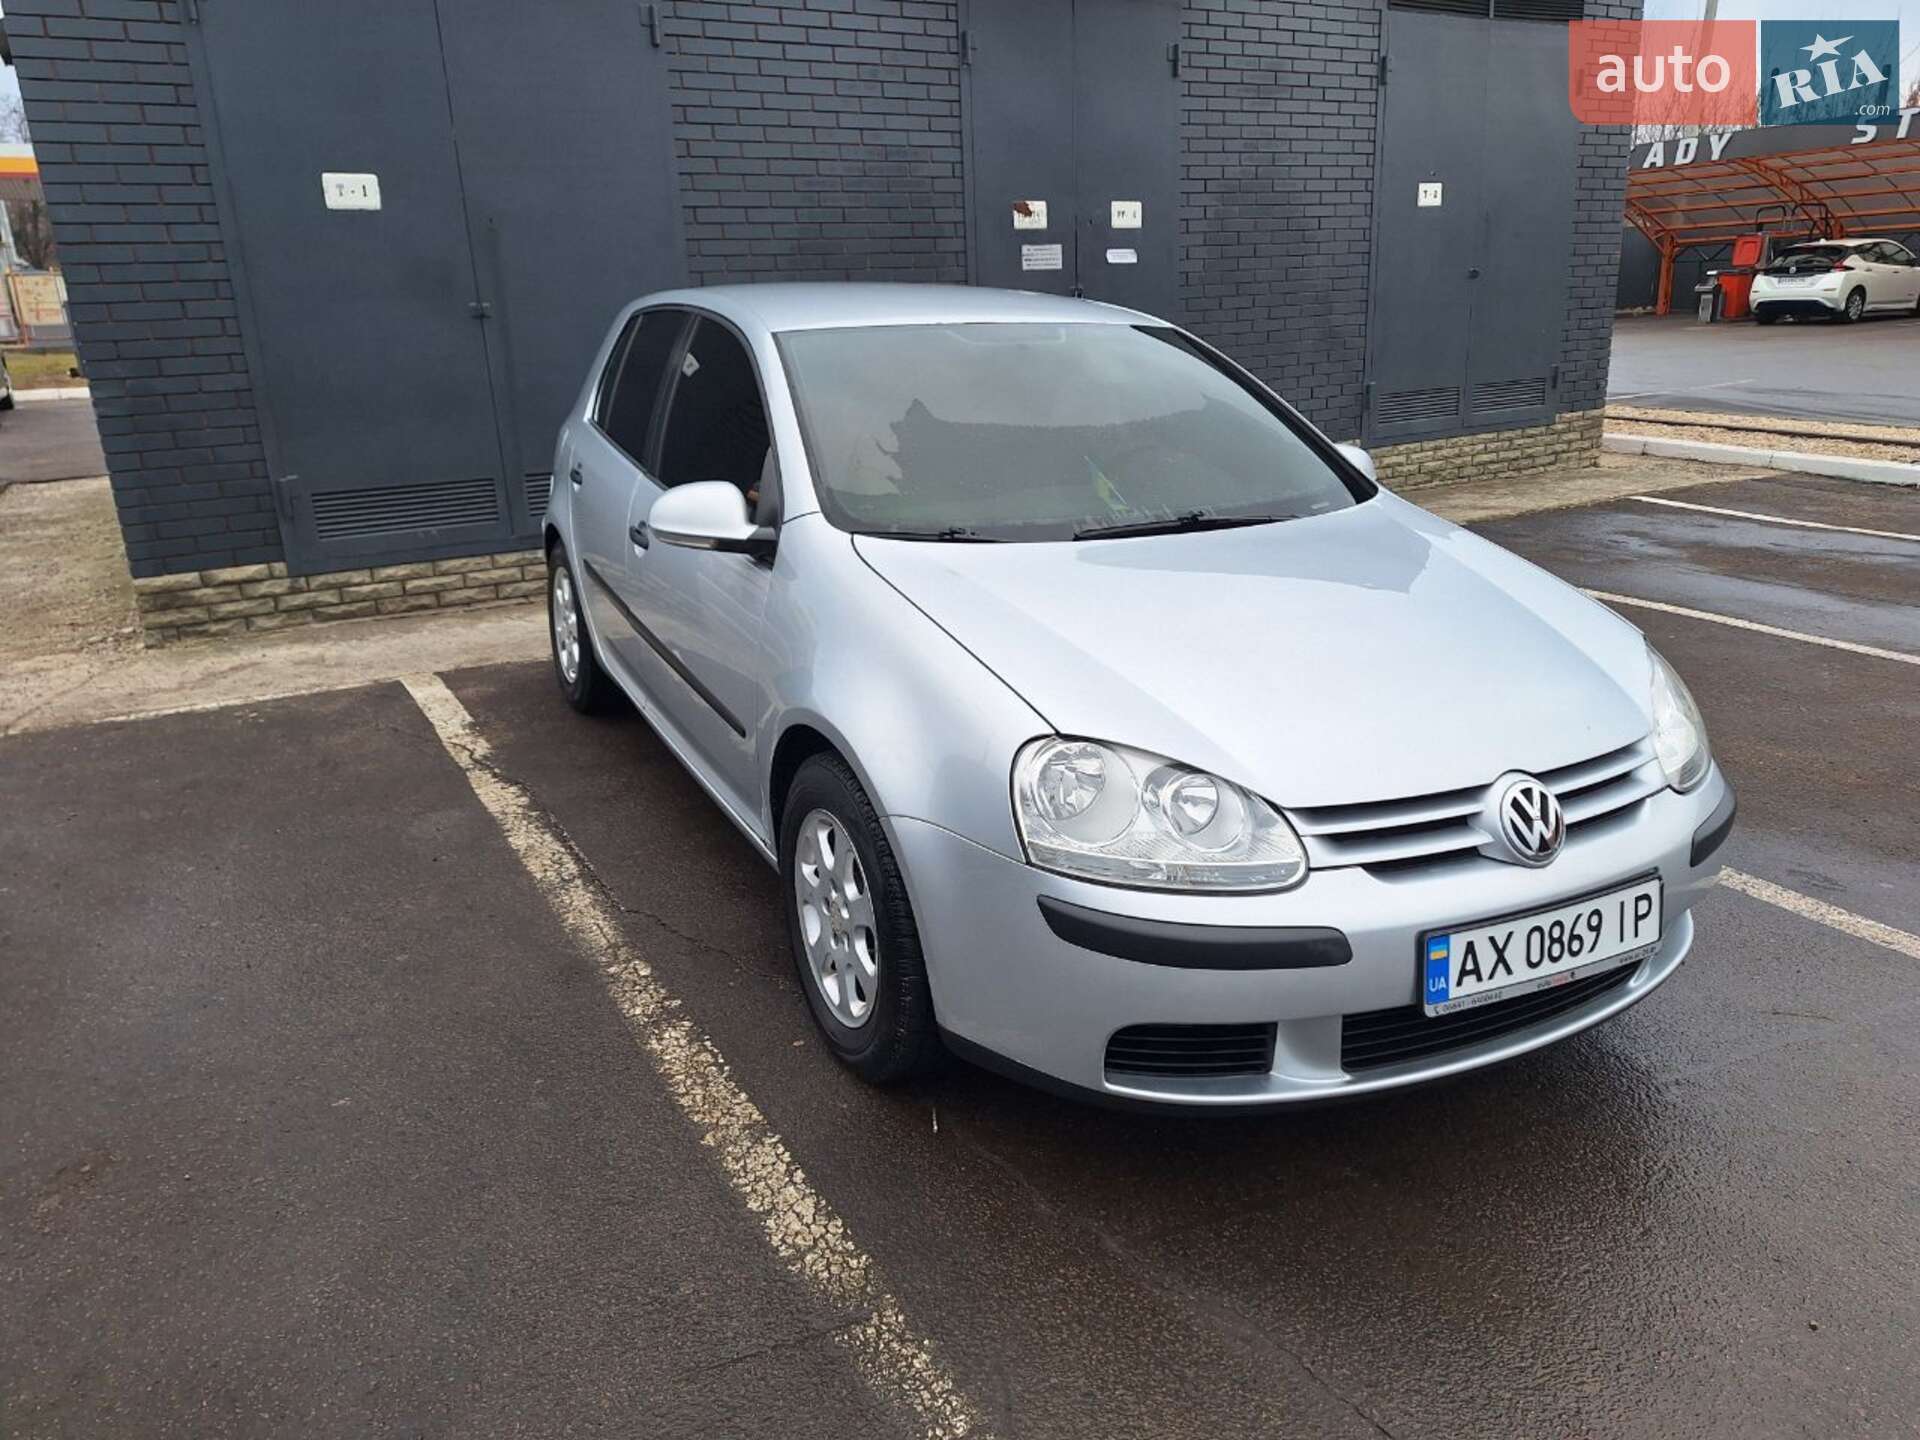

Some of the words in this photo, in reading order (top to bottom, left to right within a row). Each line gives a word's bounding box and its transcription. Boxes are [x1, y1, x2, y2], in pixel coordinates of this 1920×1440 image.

[1456, 930, 1514, 987] AX
[1526, 908, 1603, 969] 0869
[1619, 893, 1653, 943] IP
[1429, 977, 1448, 992] UA
